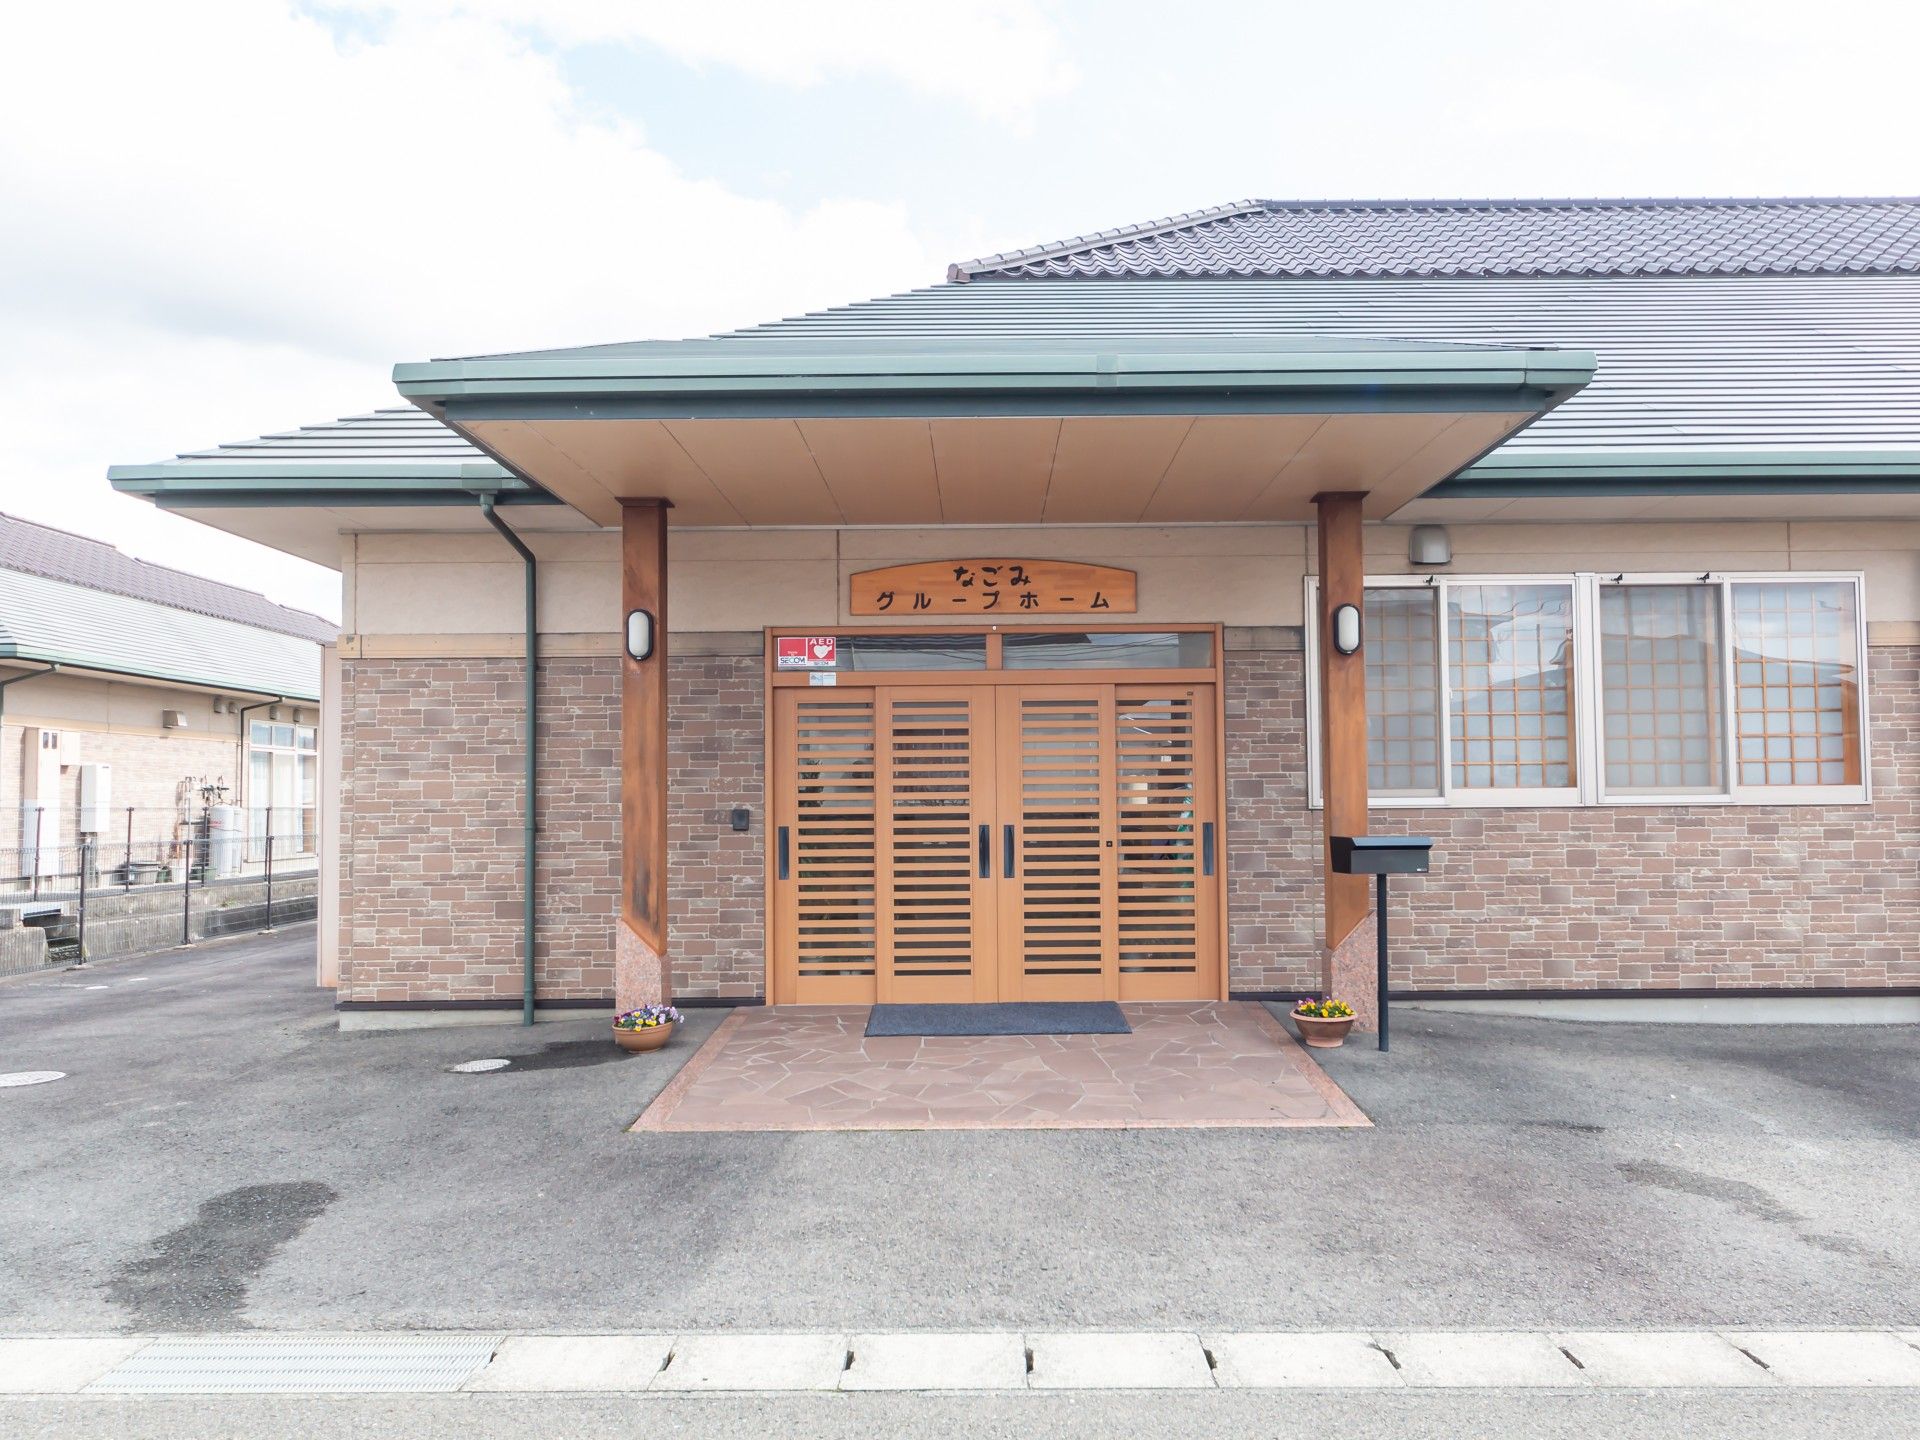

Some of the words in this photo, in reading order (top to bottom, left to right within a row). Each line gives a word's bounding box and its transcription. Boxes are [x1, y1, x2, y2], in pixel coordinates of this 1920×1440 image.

[953, 566, 1032, 587] なごみ
[876, 591, 1110, 610] グループホーム
